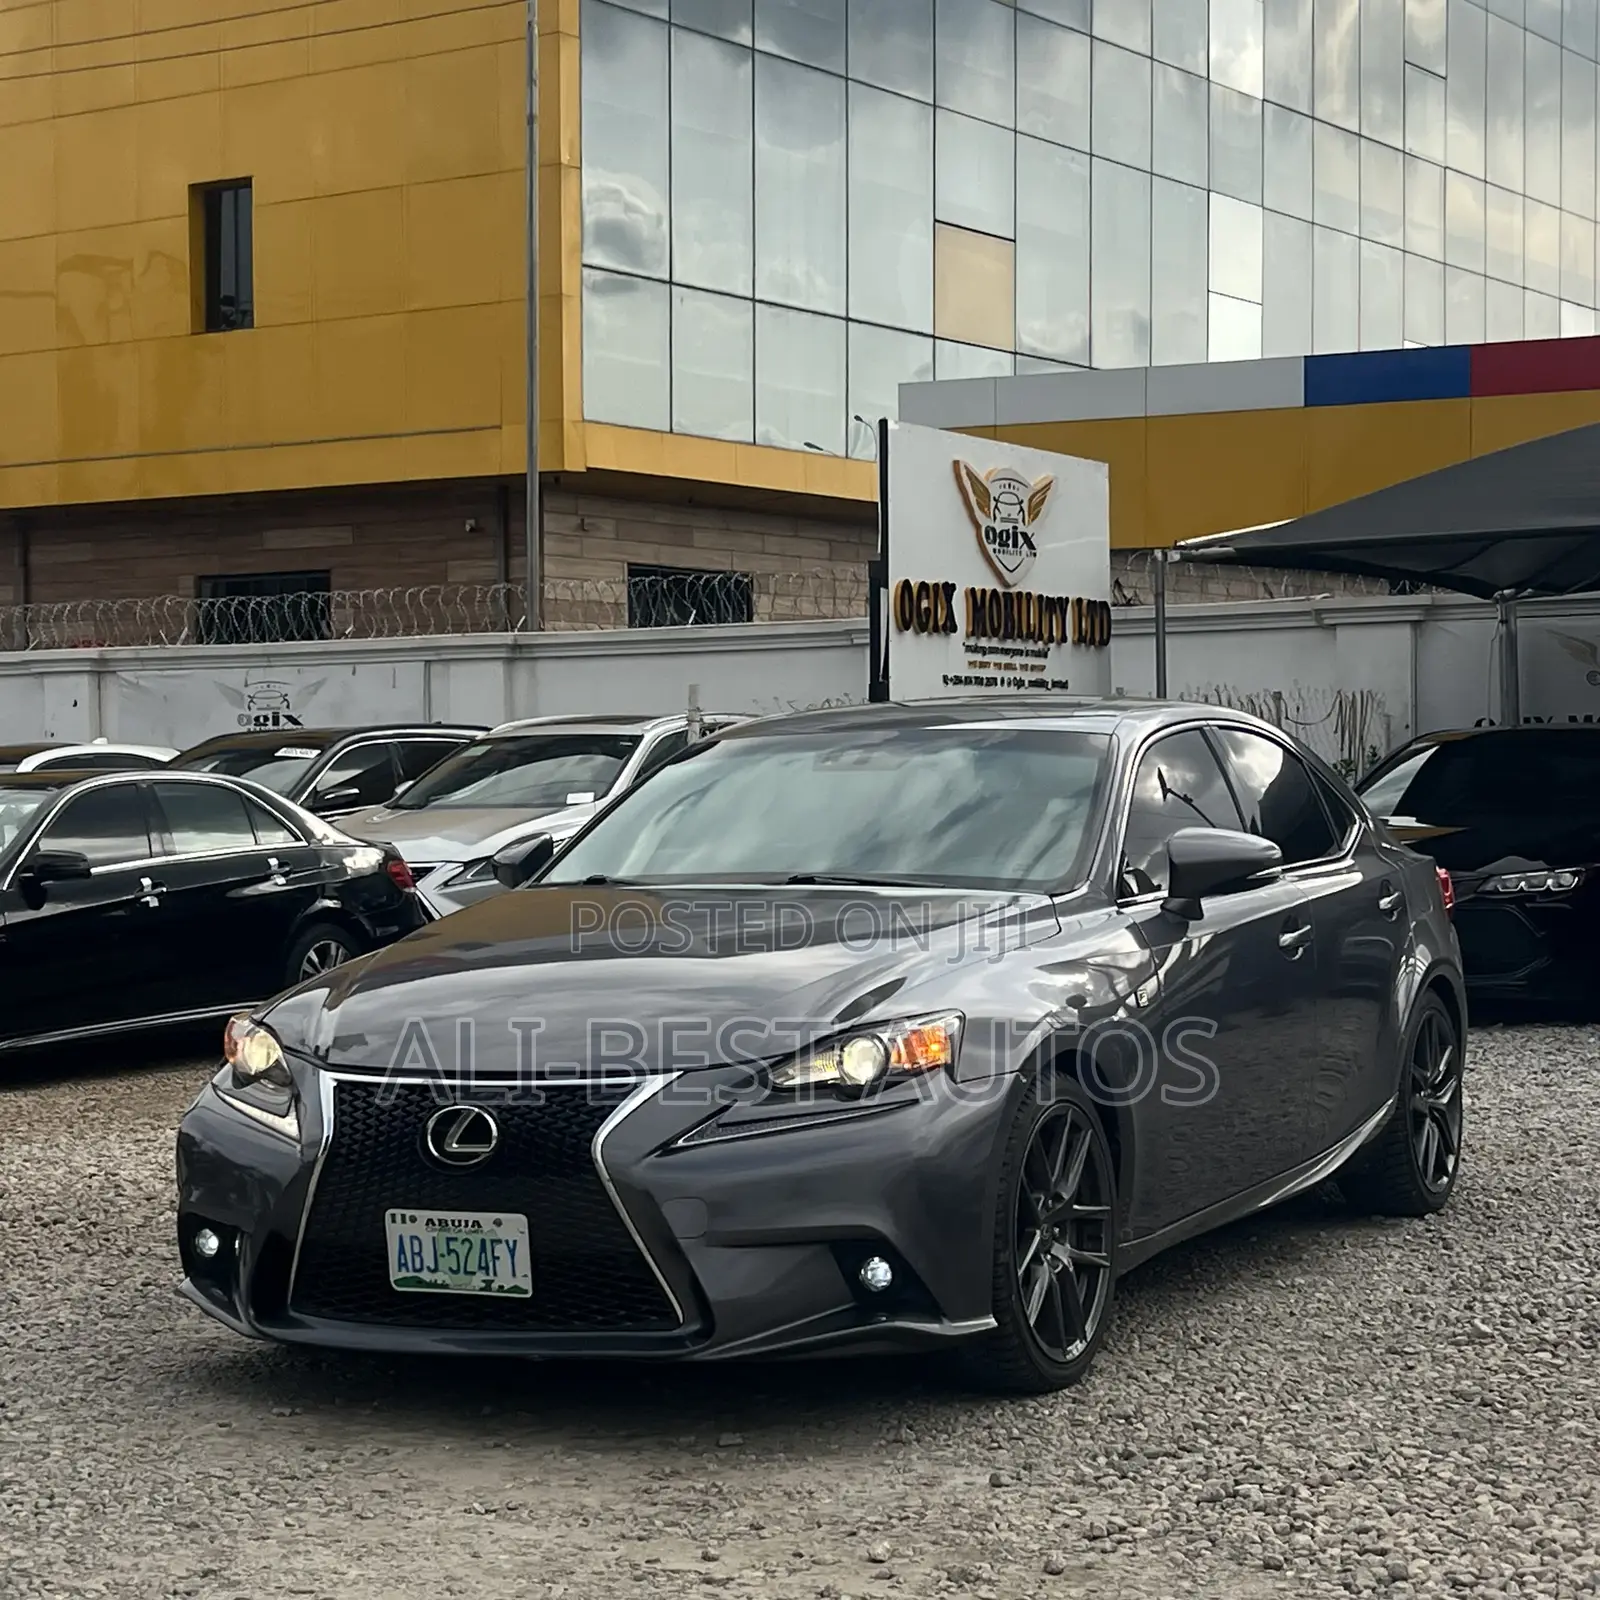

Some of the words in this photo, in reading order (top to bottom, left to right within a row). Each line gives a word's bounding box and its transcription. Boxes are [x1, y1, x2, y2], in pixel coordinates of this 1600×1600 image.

[894, 578, 958, 634] OGIX
[964, 586, 1070, 646] MOBILITY
[1071, 596, 1112, 647] LTD
[425, 1217, 483, 1229] ABUJA
[397, 1233, 518, 1279] ABJ-52AFY
